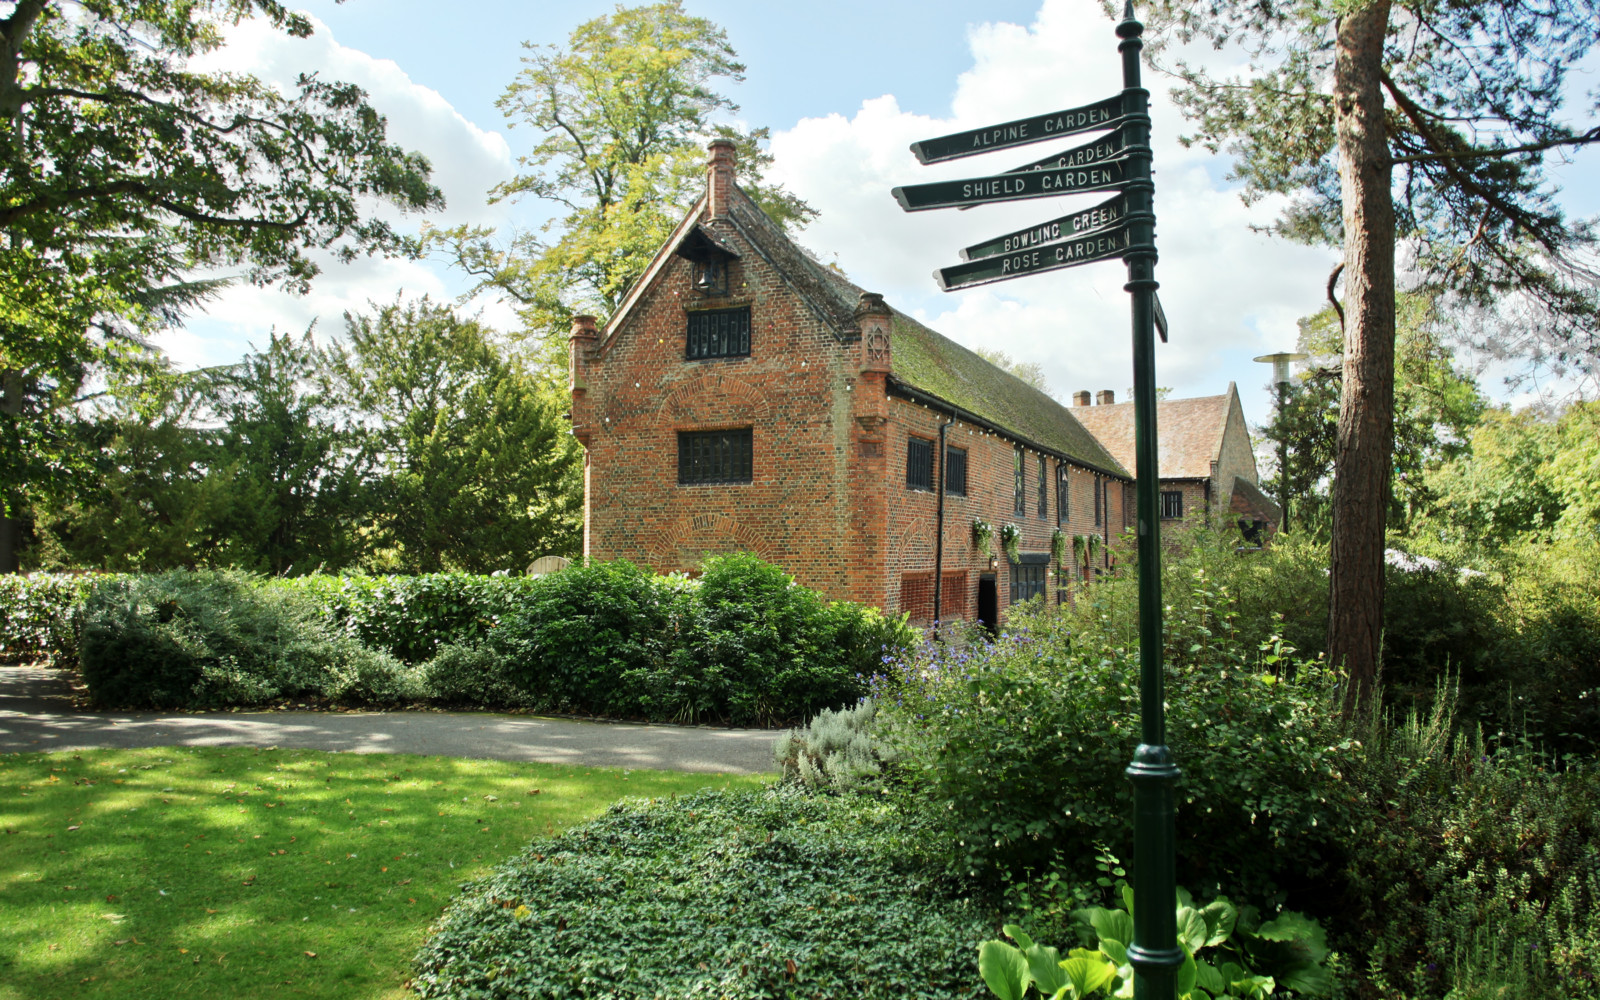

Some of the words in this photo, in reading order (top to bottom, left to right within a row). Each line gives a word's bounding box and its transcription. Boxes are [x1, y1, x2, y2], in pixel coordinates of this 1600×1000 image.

[973, 124, 1029, 147] ALPINE
[1044, 107, 1110, 132] GARDEN
[1058, 142, 1114, 168] GARDEN
[963, 178, 1026, 198] SHIELD
[1042, 169, 1112, 189] GARDEN
[1004, 223, 1060, 252] BOWLING
[1073, 206, 1117, 231] GREEN
[1002, 252, 1040, 273] ROSE
[1055, 237, 1117, 261] GARDEN
